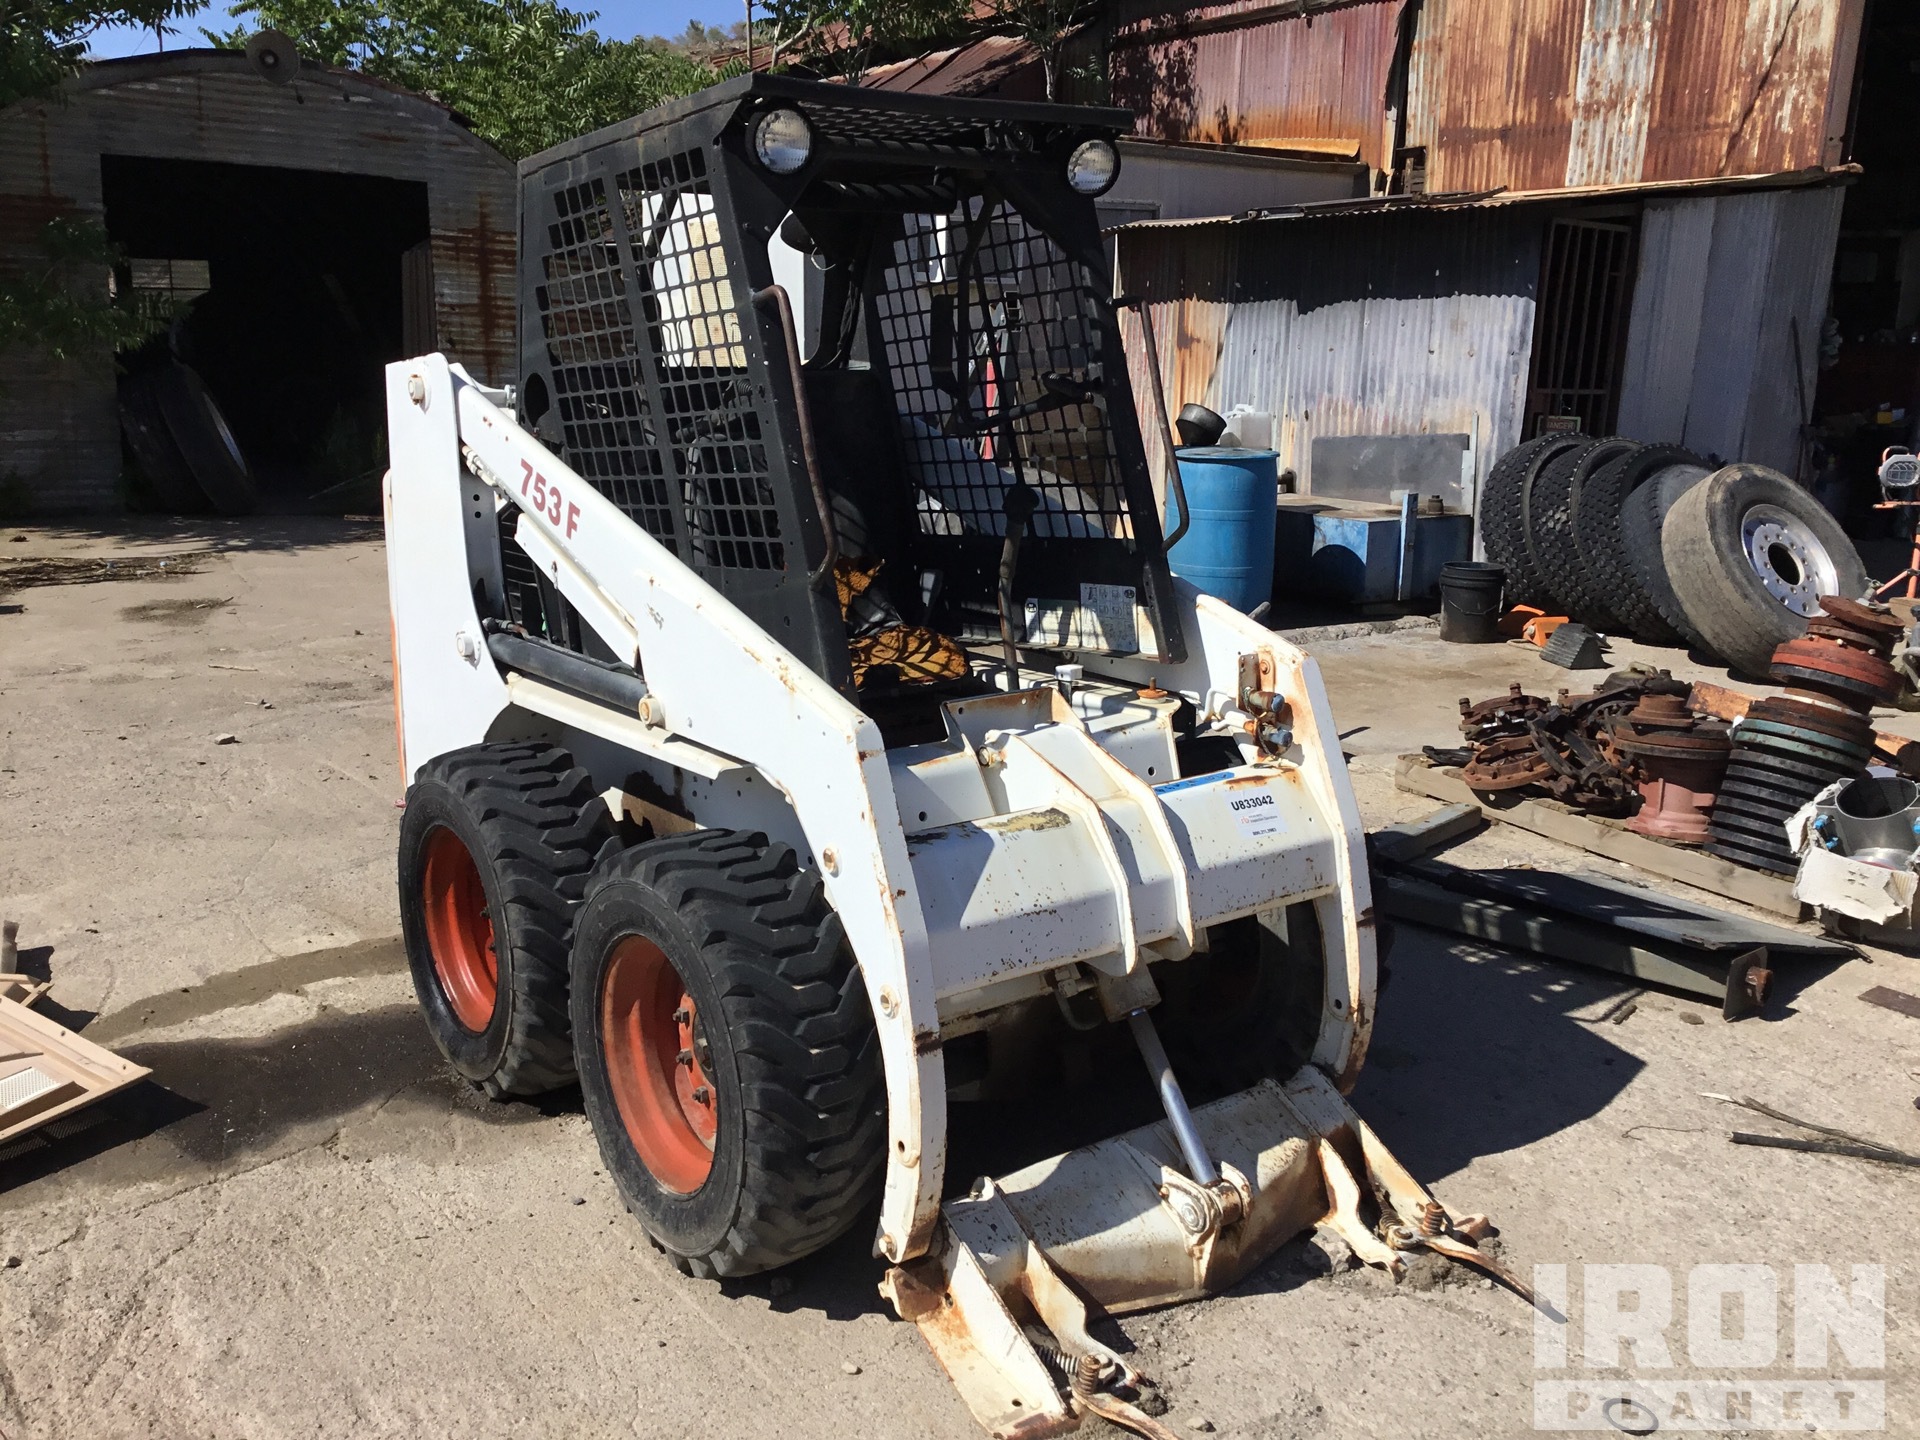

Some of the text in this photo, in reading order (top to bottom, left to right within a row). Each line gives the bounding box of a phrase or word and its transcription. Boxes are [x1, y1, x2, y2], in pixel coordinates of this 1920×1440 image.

[521, 458, 581, 540] 753 F
[1231, 795, 1274, 811] U833042
